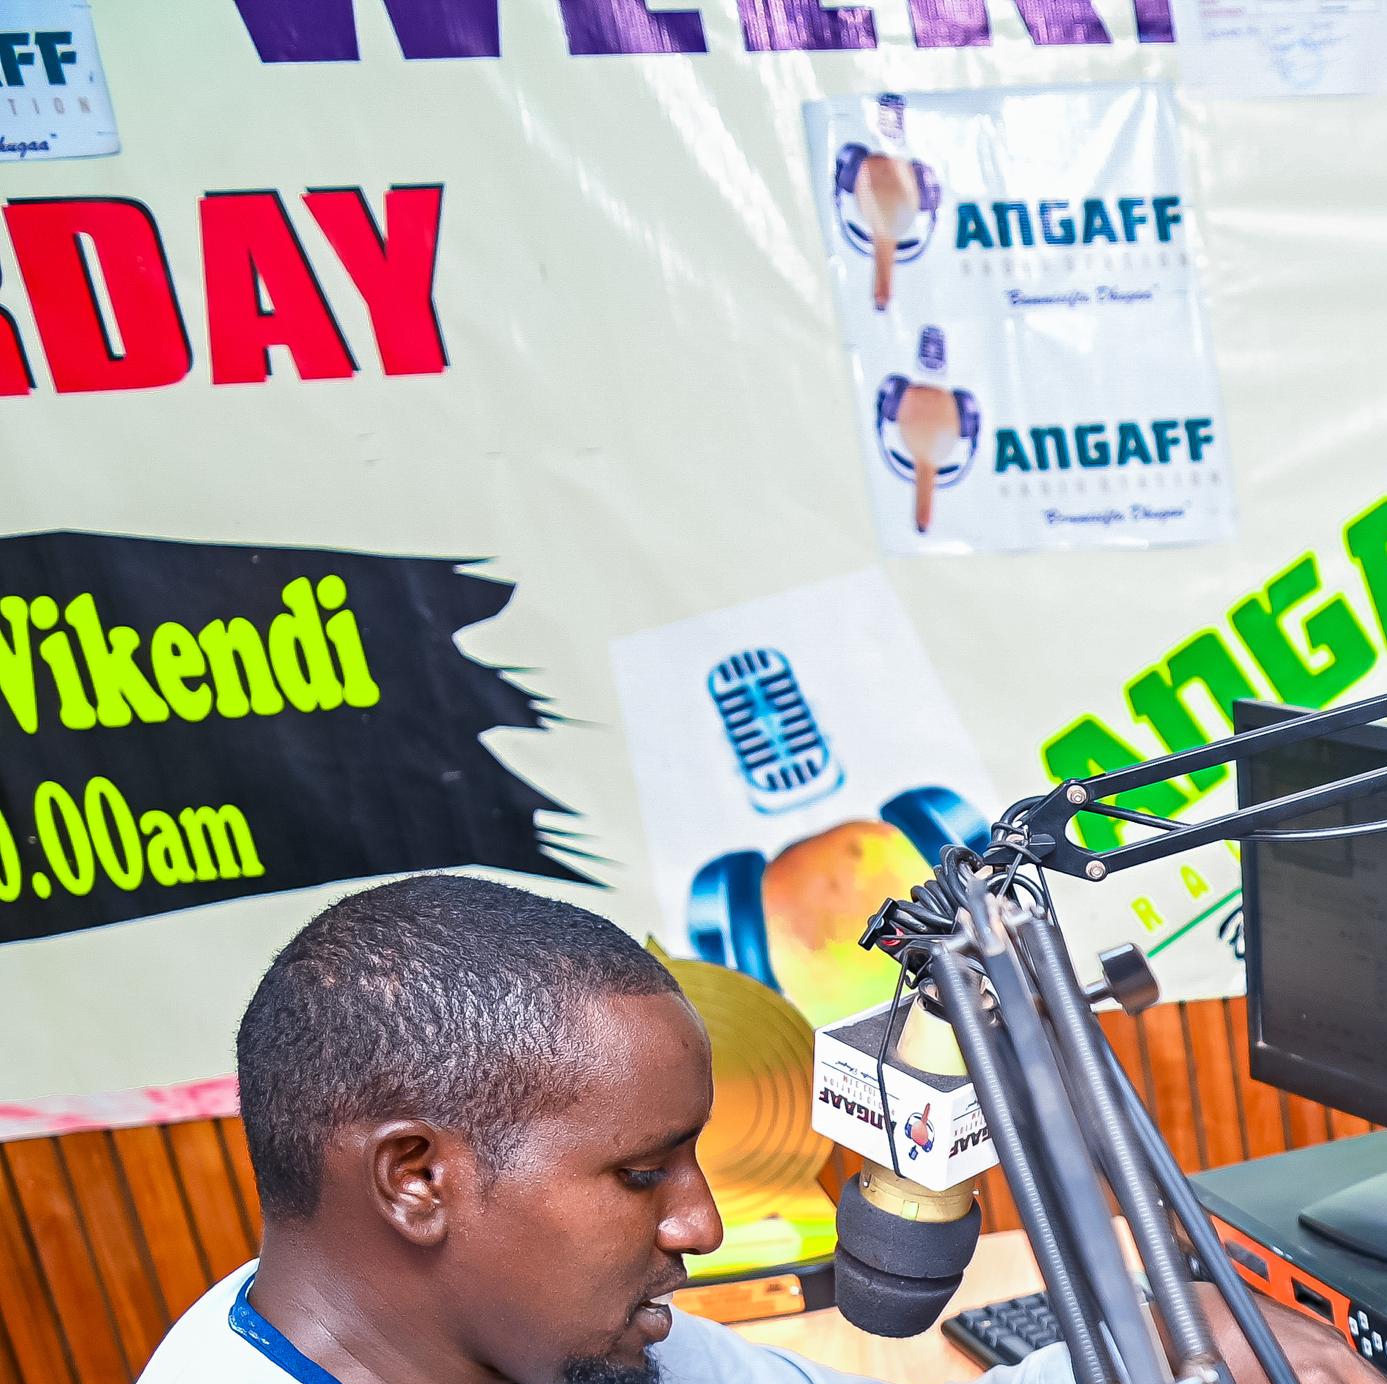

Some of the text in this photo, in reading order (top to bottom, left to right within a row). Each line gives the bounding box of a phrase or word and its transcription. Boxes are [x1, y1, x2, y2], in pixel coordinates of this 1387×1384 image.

[0, 31, 77, 86] FF
[956, 196, 1183, 249] ANGAFF
[994, 418, 1214, 473] ANGAFF
